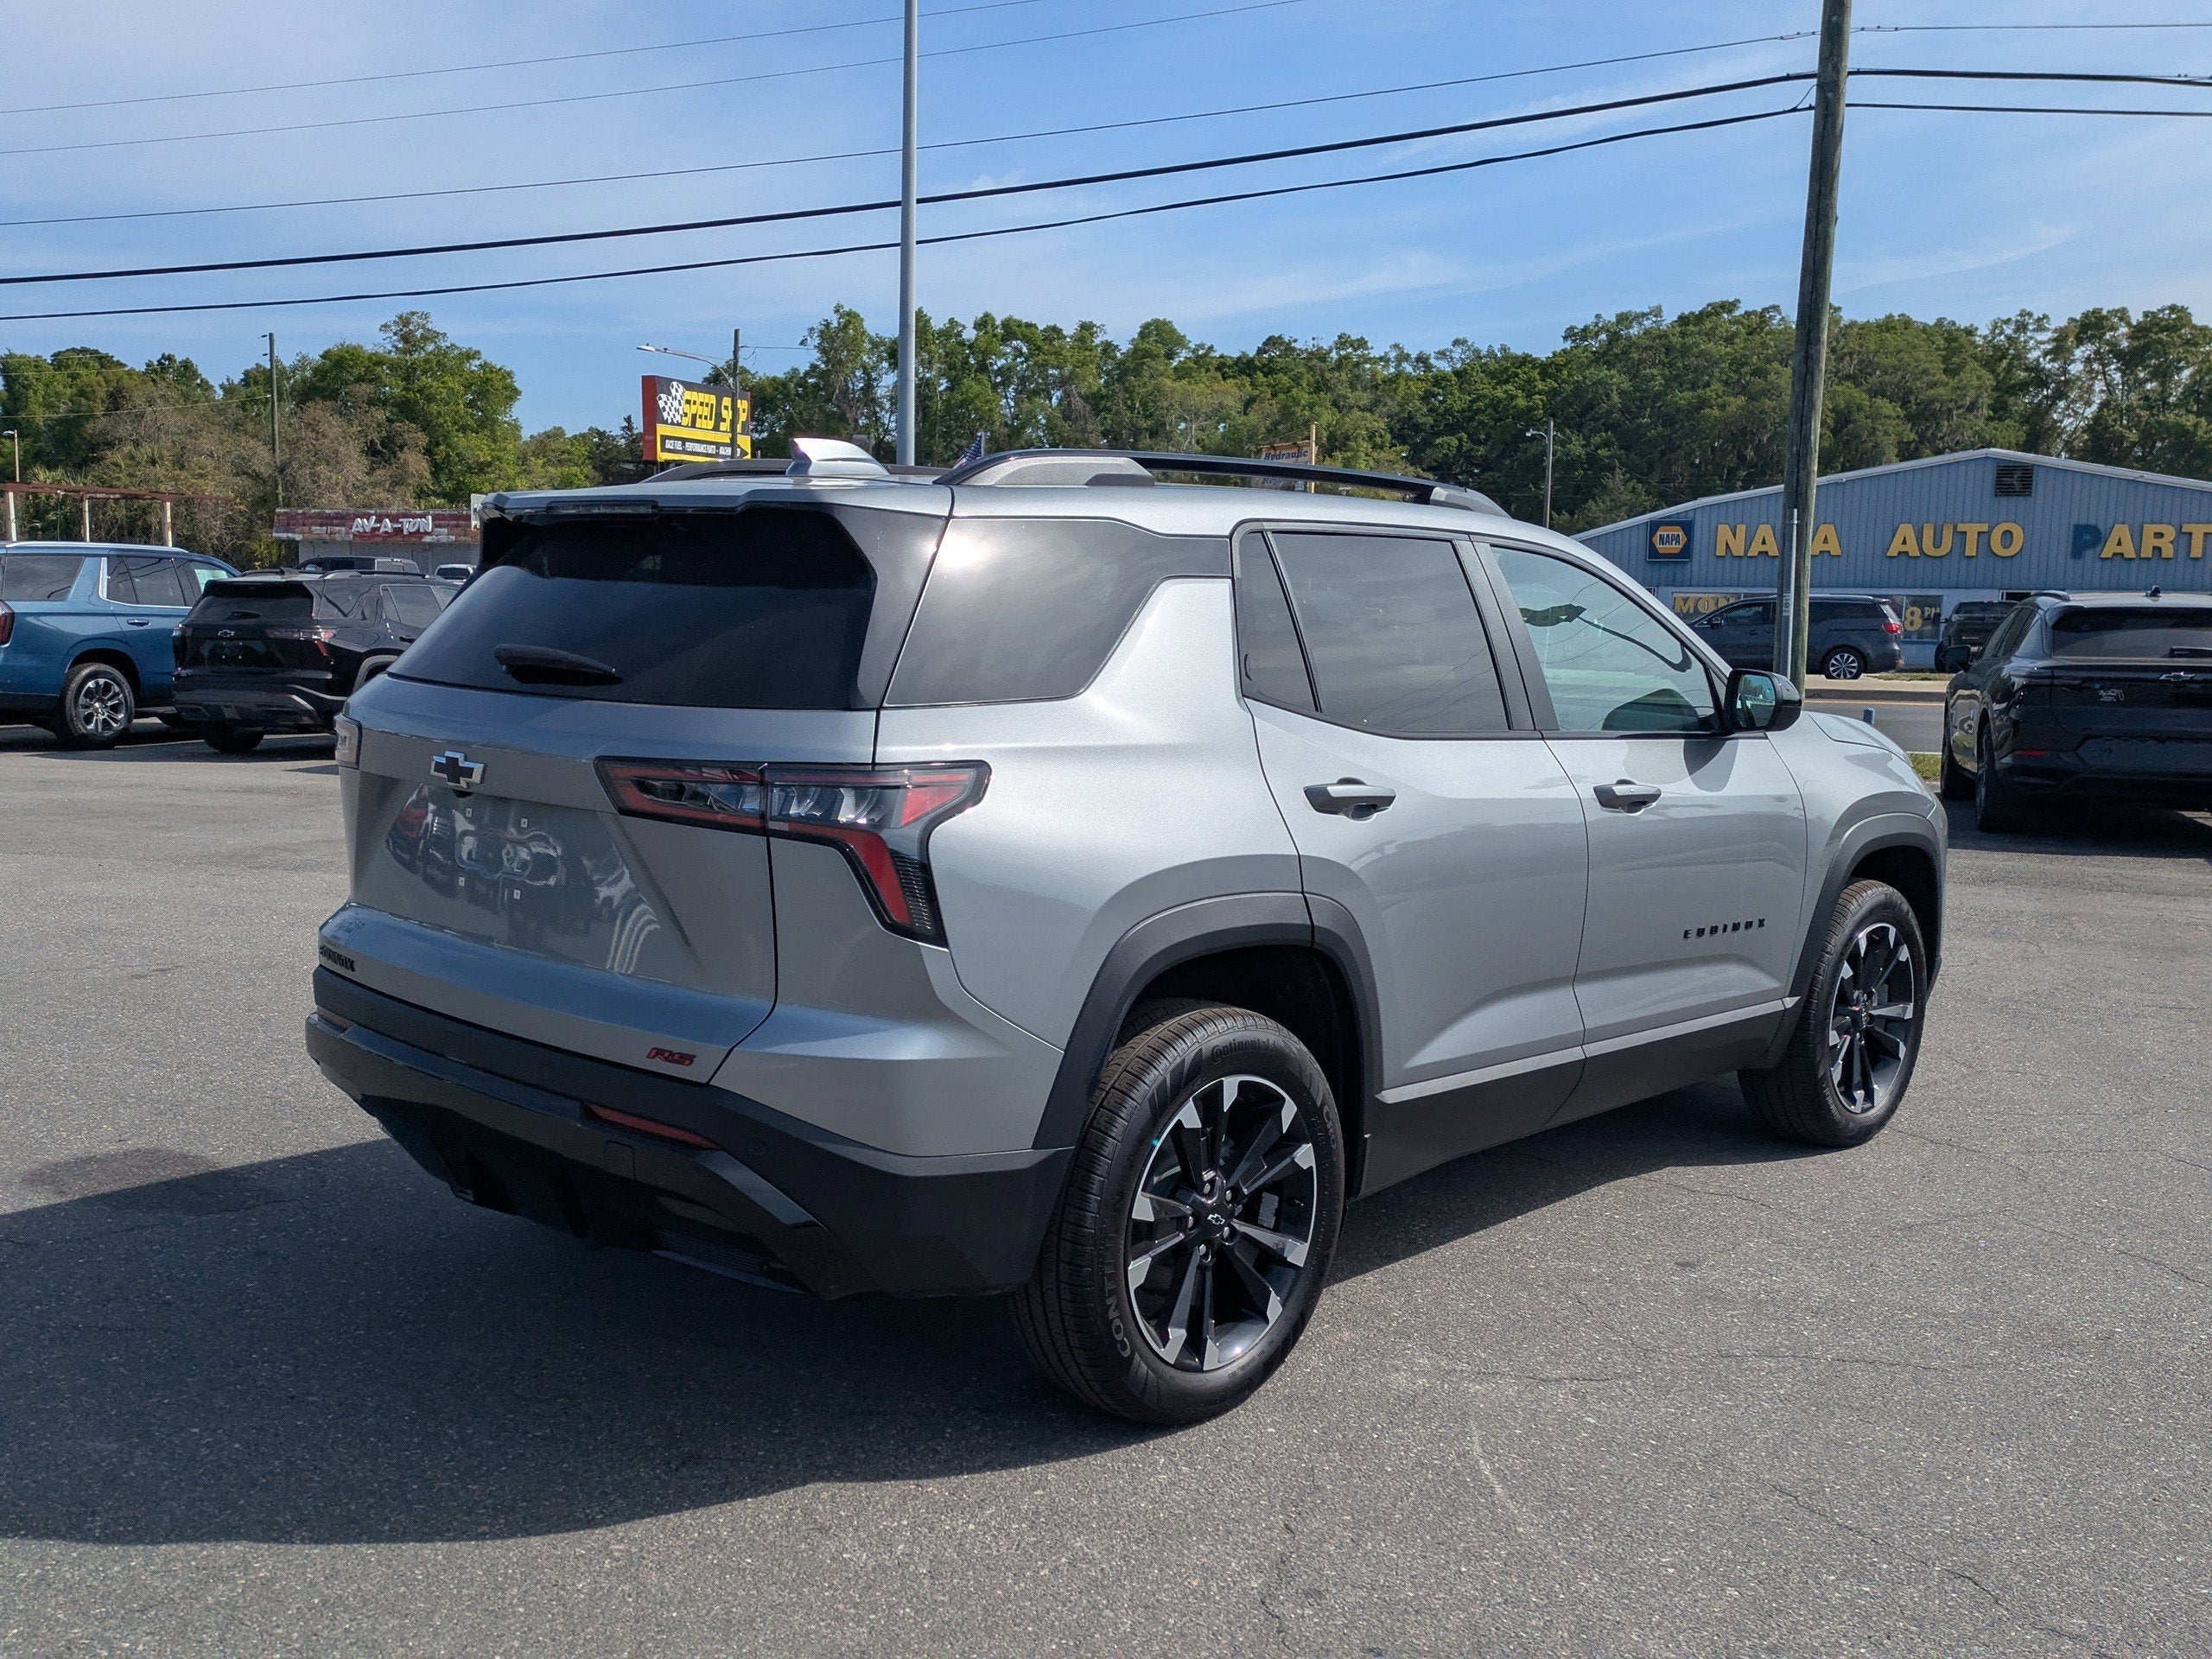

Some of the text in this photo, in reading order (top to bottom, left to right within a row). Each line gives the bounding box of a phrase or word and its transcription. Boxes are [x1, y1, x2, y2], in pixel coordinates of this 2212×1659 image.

[681, 391, 716, 429] SPEED
[352, 515, 433, 536] AV-A-TON
[1658, 533, 1681, 546] NAPA
[1715, 523, 1842, 556] NAA
[1885, 522, 2024, 557] AUTO
[1904, 606, 1923, 631] 8
[1682, 918, 1766, 939] EQUINOX
[645, 1046, 697, 1067] RS
